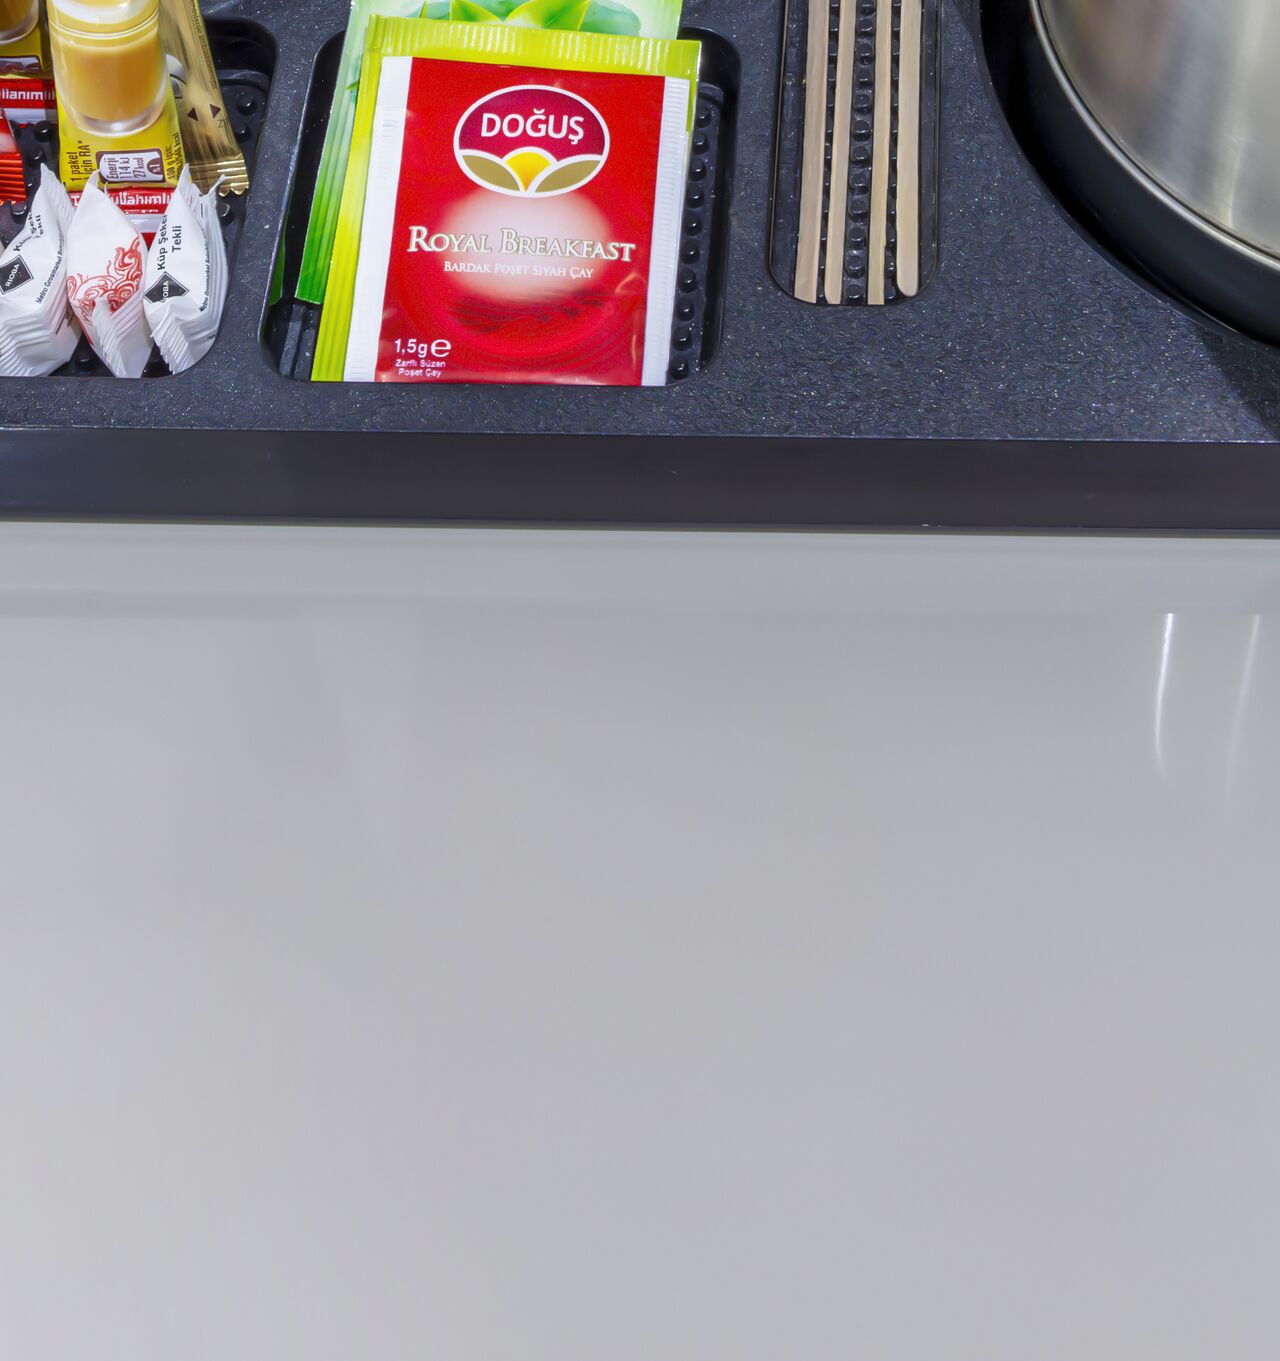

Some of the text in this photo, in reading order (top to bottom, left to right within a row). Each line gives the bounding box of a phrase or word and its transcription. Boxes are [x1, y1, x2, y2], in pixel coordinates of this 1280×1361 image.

[481, 108, 584, 145] DOĞUŞ
[104, 157, 119, 179] Enerji
[133, 170, 146, 178] 27
[171, 225, 182, 253] Tekli
[406, 225, 637, 262] ROYAL BREAKFAST
[156, 247, 168, 271] Küp
[444, 260, 490, 274] BARDAK
[4, 263, 21, 288] RIOBA
